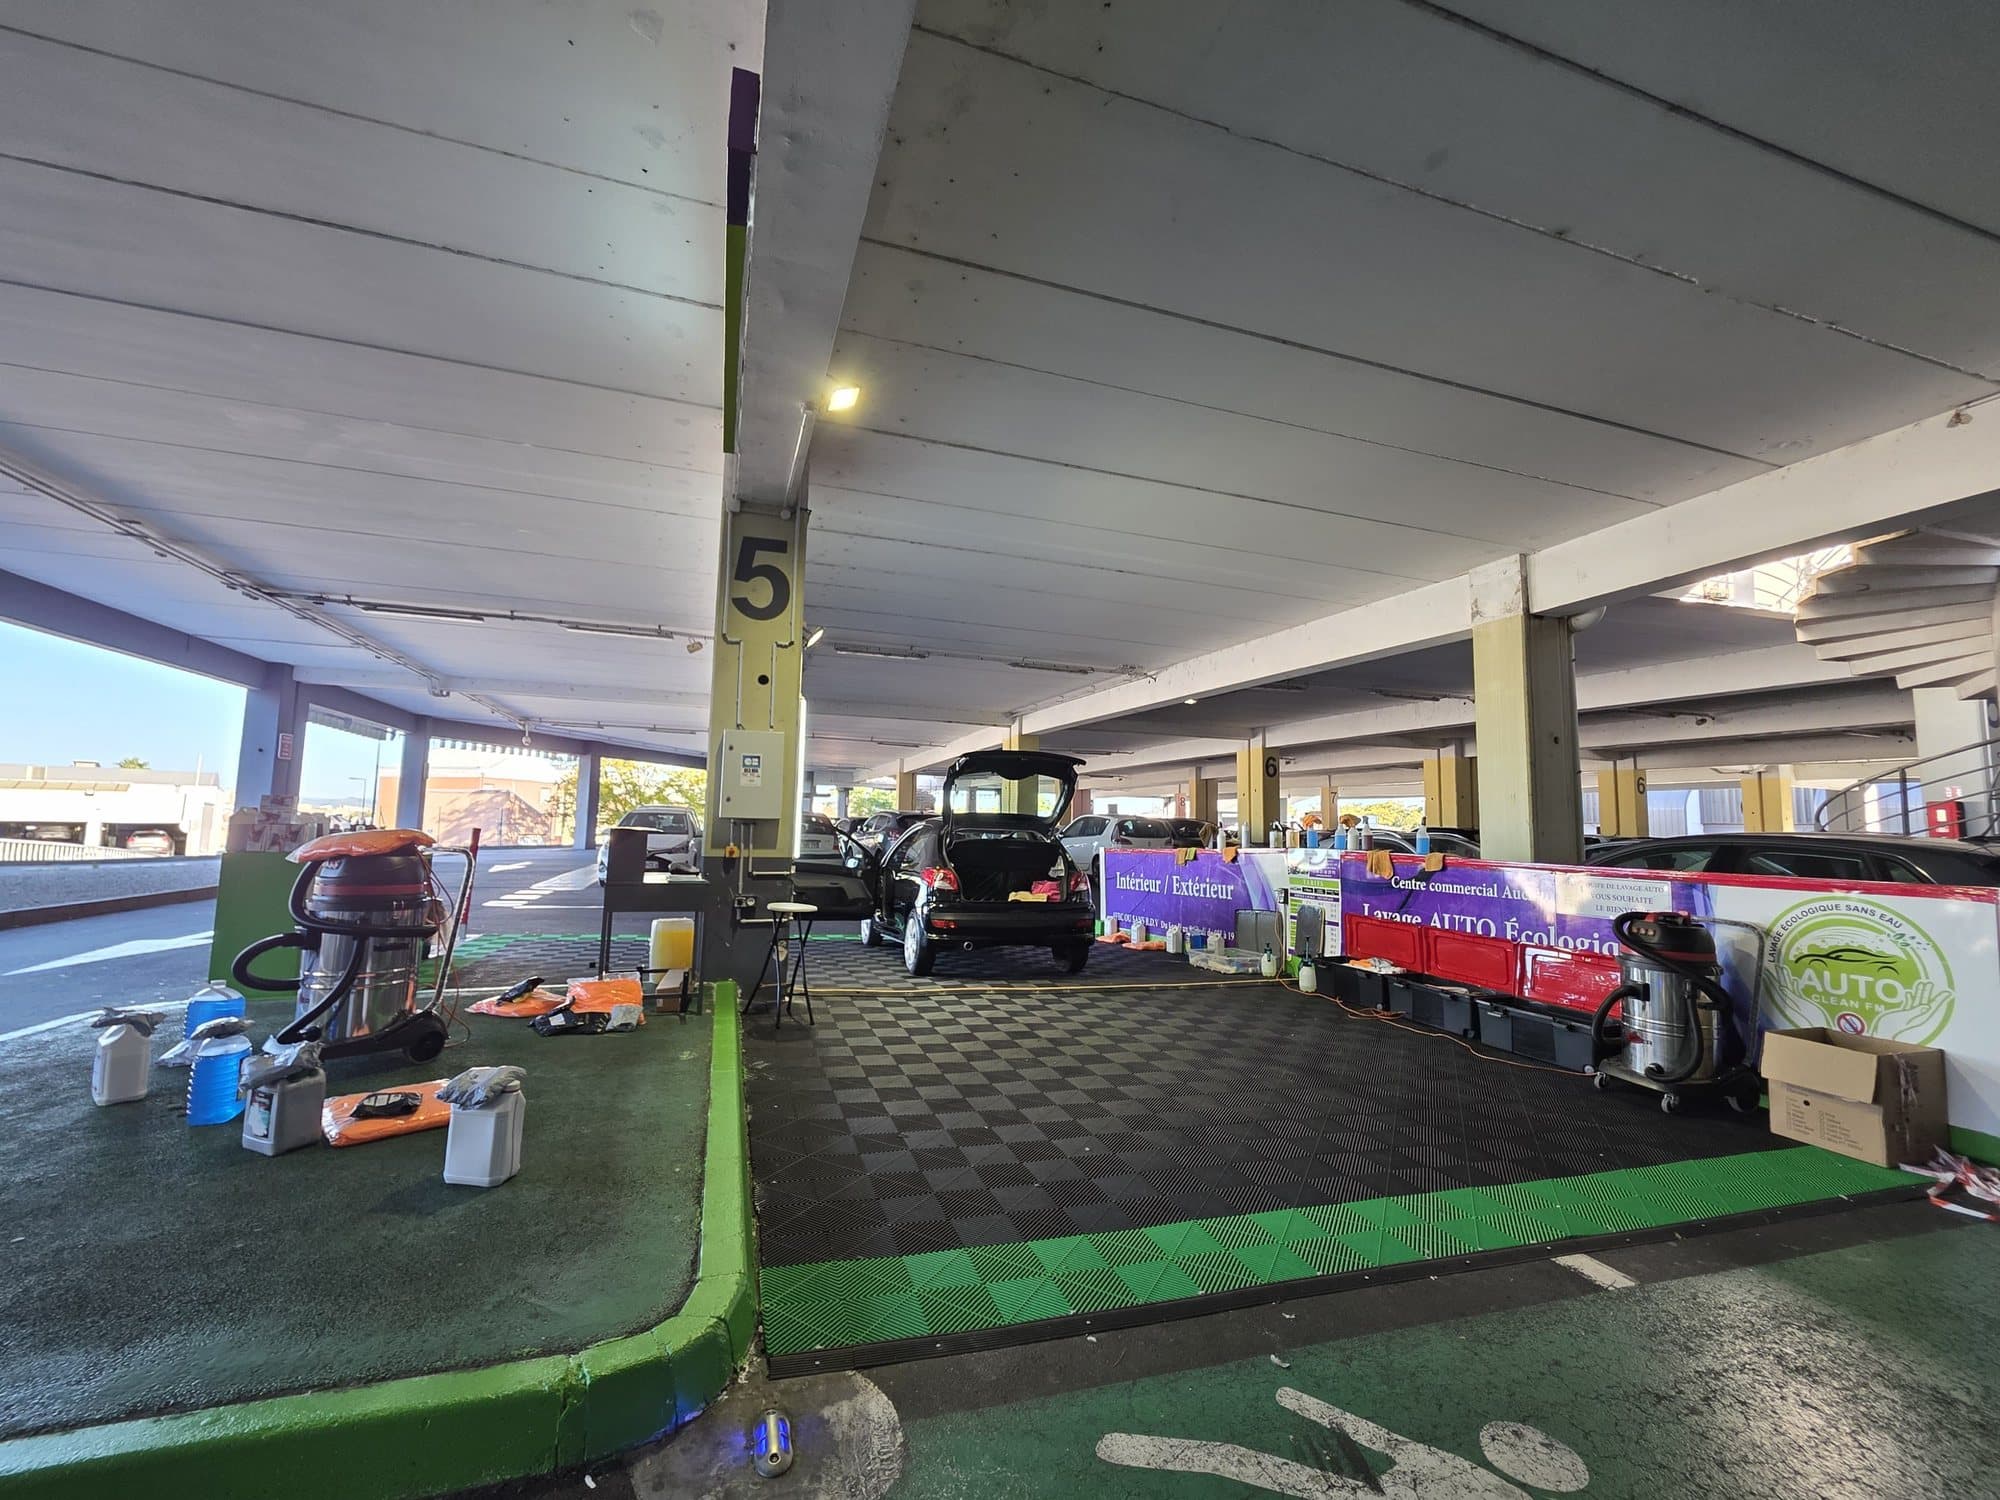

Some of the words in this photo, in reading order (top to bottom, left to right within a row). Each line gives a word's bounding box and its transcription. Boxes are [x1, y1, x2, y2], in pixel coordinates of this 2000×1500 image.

[731, 536, 790, 621] 5
[1265, 756, 1277, 777] 6
[1637, 777, 1645, 794] 6
[1331, 792, 1338, 803] 7
[1116, 872, 1161, 893] Intérieur
[1164, 878, 1170, 894] /
[1172, 875, 1234, 900] Extérieur
[1391, 876, 1426, 891] Centre
[1429, 881, 1498, 898] commercial
[1615, 884, 1641, 892] LAVAGE
[1612, 895, 1653, 905] SOUHAITE
[1430, 911, 1496, 938] AUTO
[1768, 931, 1784, 963] LAVAGE
[1782, 903, 1841, 932] ÉCOLOGIQUE
[1845, 904, 1876, 917] SANS
[1879, 913, 1903, 929] EAU
[1800, 967, 1905, 1004] AUTO
[1811, 993, 1860, 1009] CLEAN
